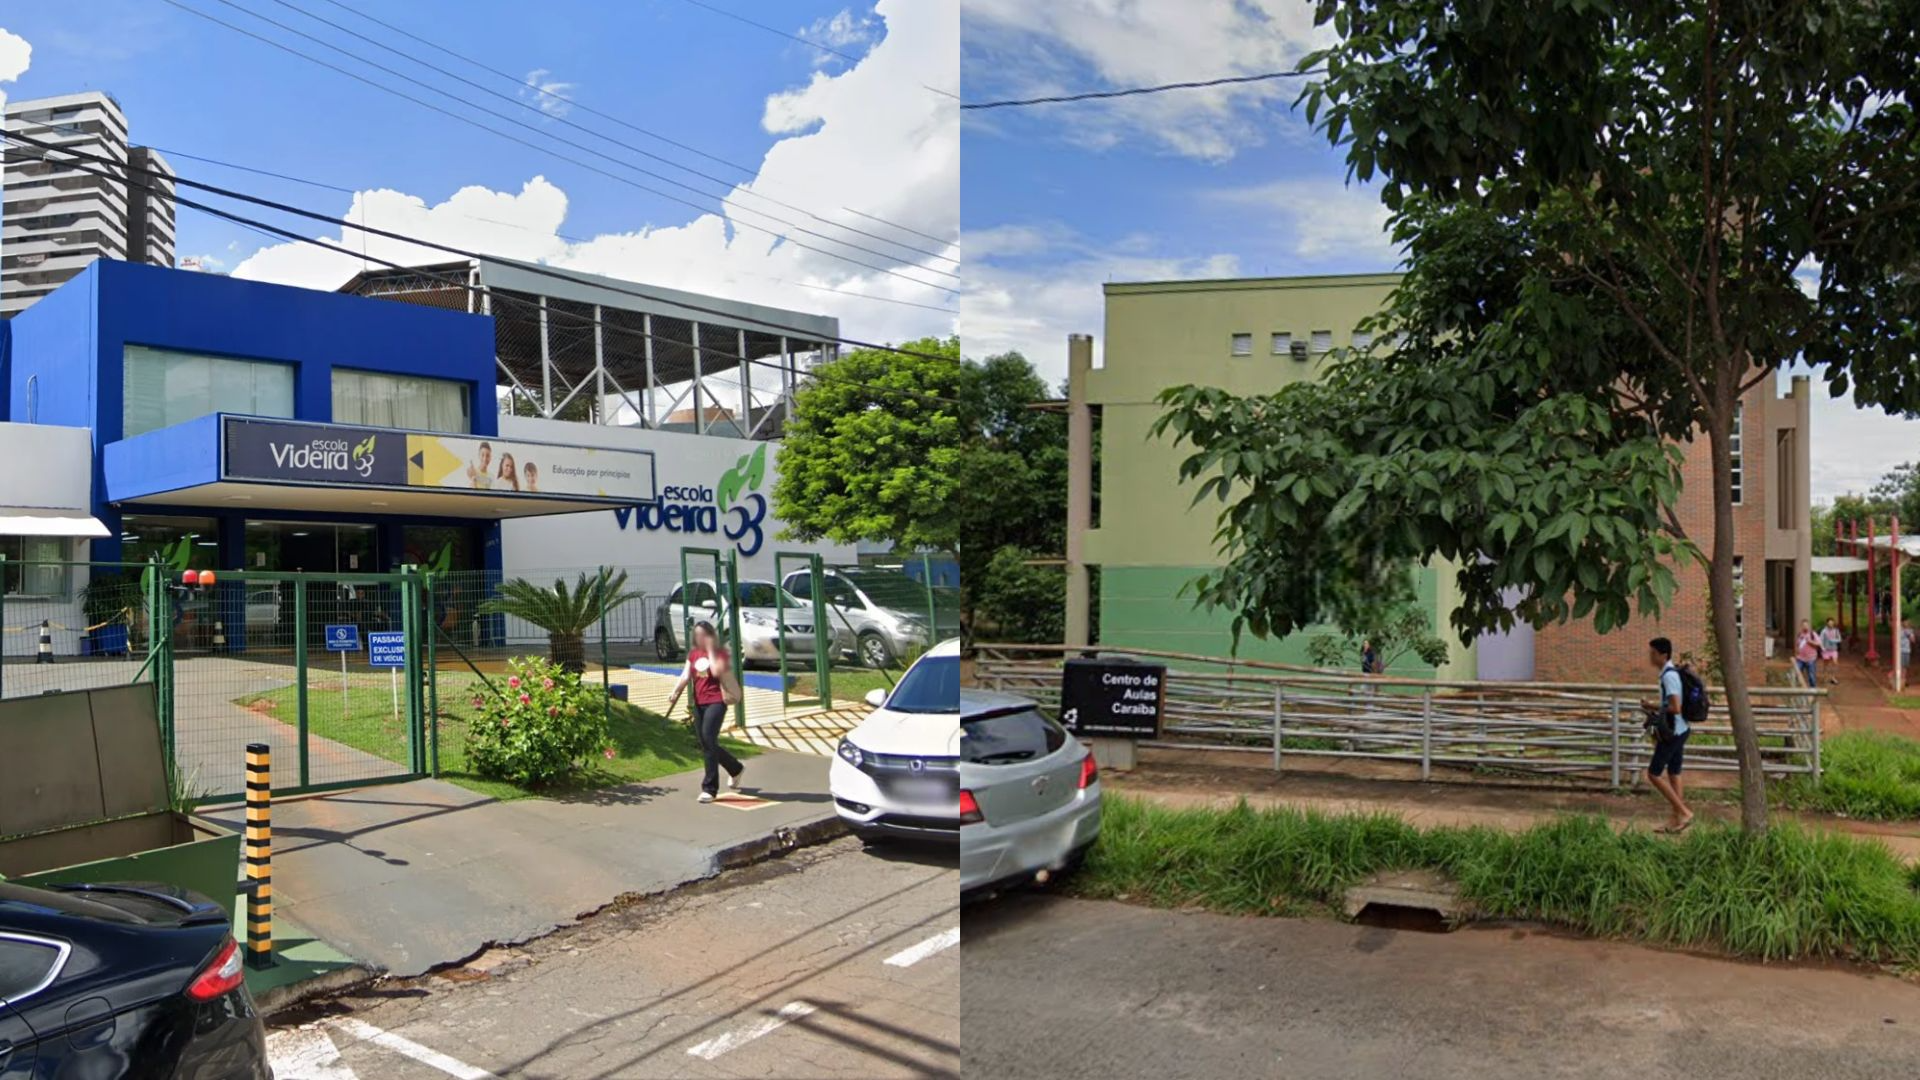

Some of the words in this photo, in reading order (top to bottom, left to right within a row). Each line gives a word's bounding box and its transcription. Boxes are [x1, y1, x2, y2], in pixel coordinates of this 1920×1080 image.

[312, 439, 348, 451] escola
[269, 442, 348, 470] Videira
[552, 464, 586, 477] Educação
[586, 469, 599, 478] por
[663, 485, 713, 503] escola
[372, 636, 404, 644] PASSAGE
[373, 646, 405, 654] EXCLUSI
[383, 654, 405, 662] VEÍCUL
[1102, 673, 1141, 685] Centro
[1143, 674, 1158, 686] de
[1123, 688, 1157, 700] Aulas
